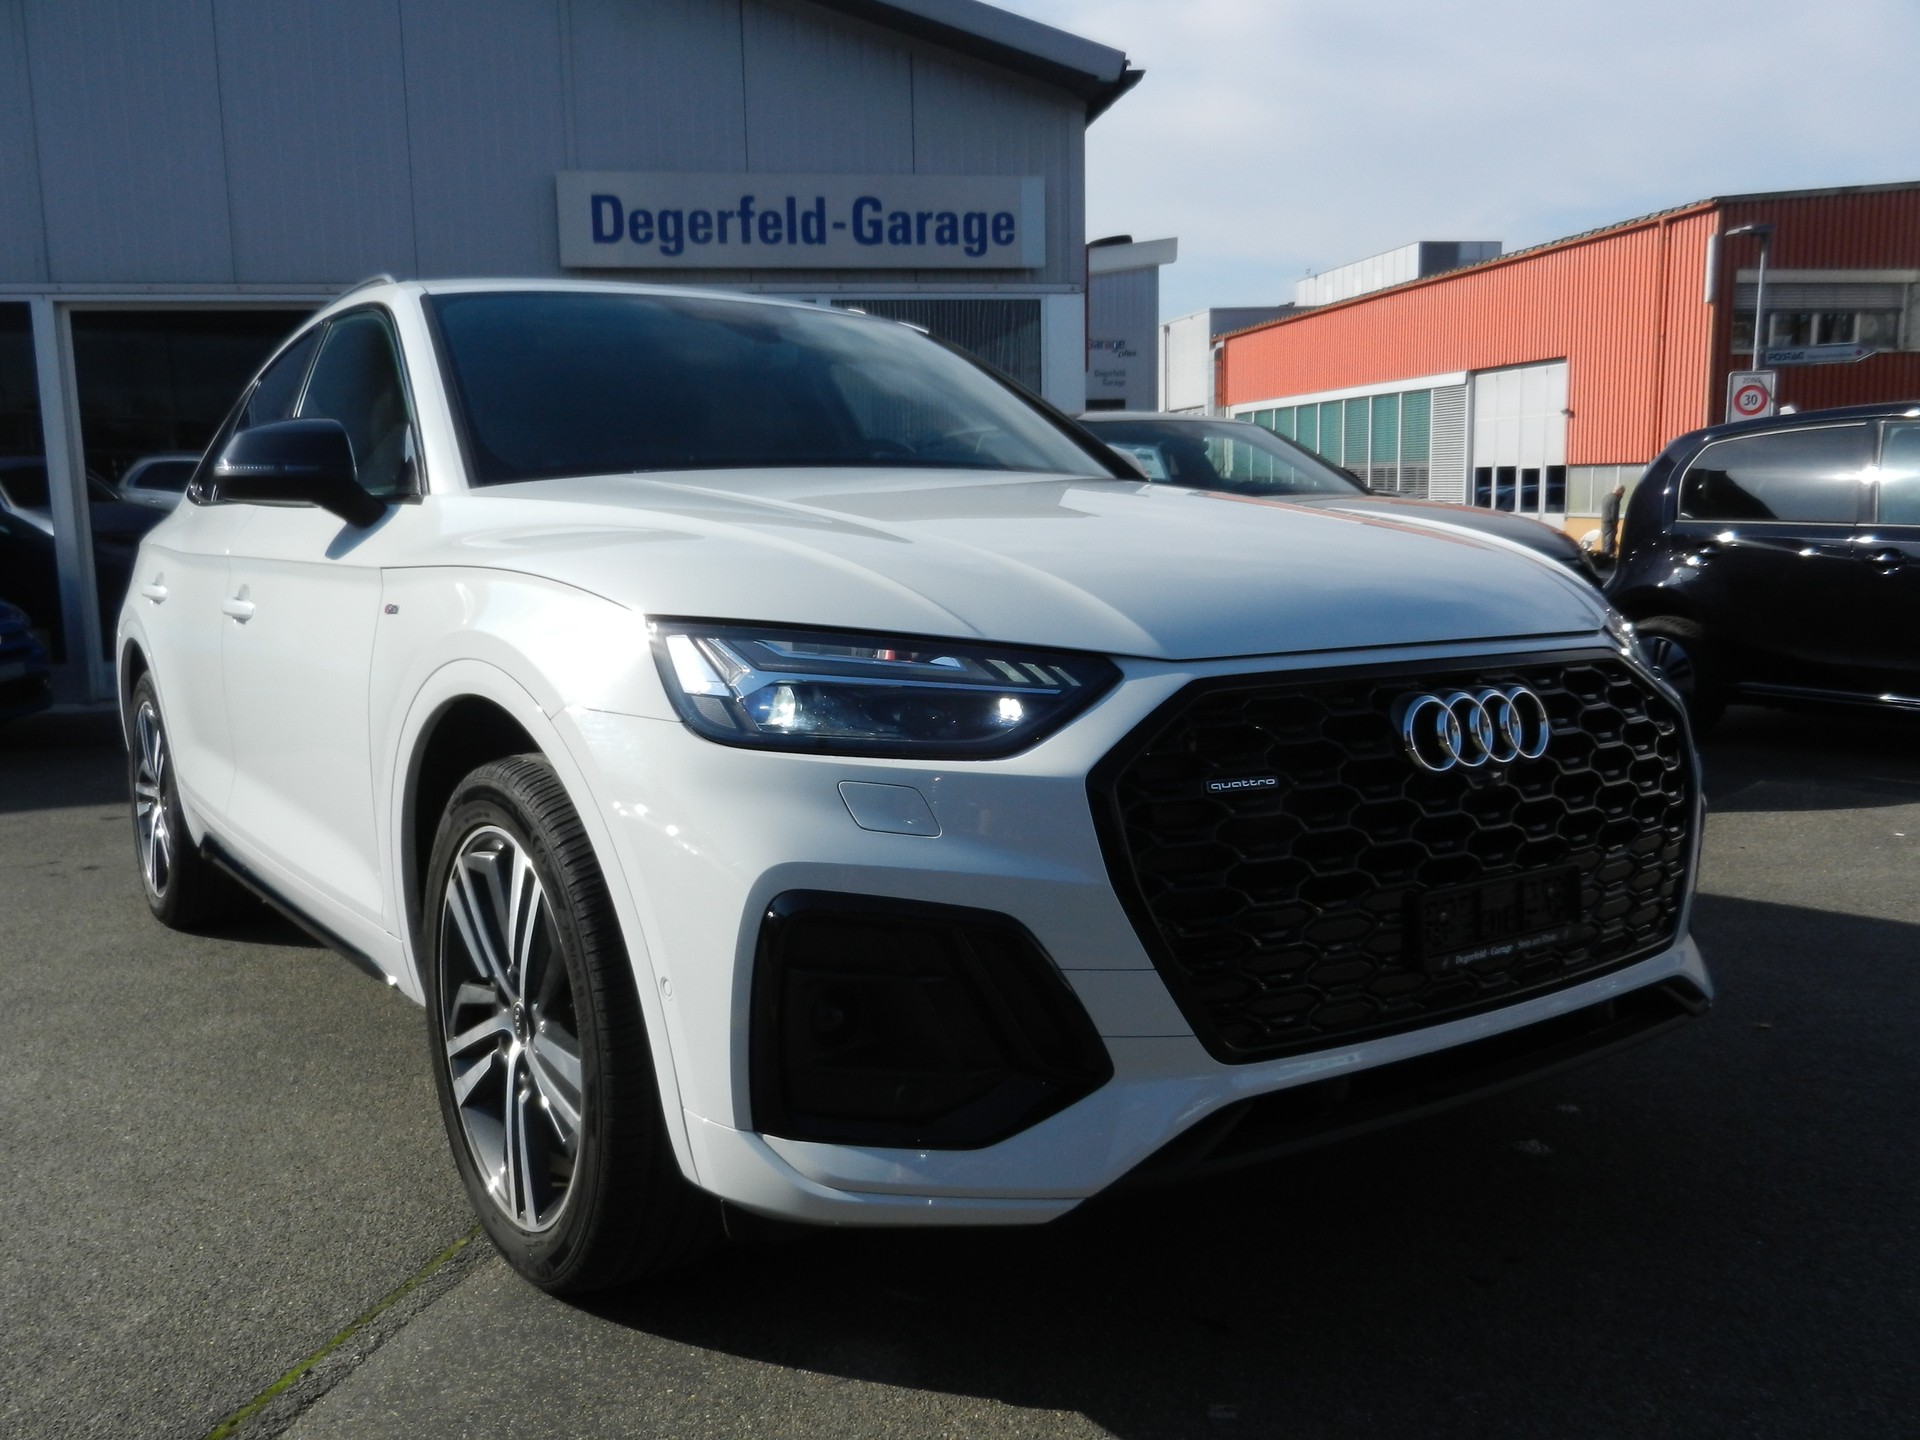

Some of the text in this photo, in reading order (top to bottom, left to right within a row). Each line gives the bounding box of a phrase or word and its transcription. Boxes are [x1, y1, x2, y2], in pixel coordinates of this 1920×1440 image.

[590, 194, 1016, 258] Degerfeld-Garage
[1744, 394, 1758, 406] 30
[1210, 778, 1276, 791] quattro
